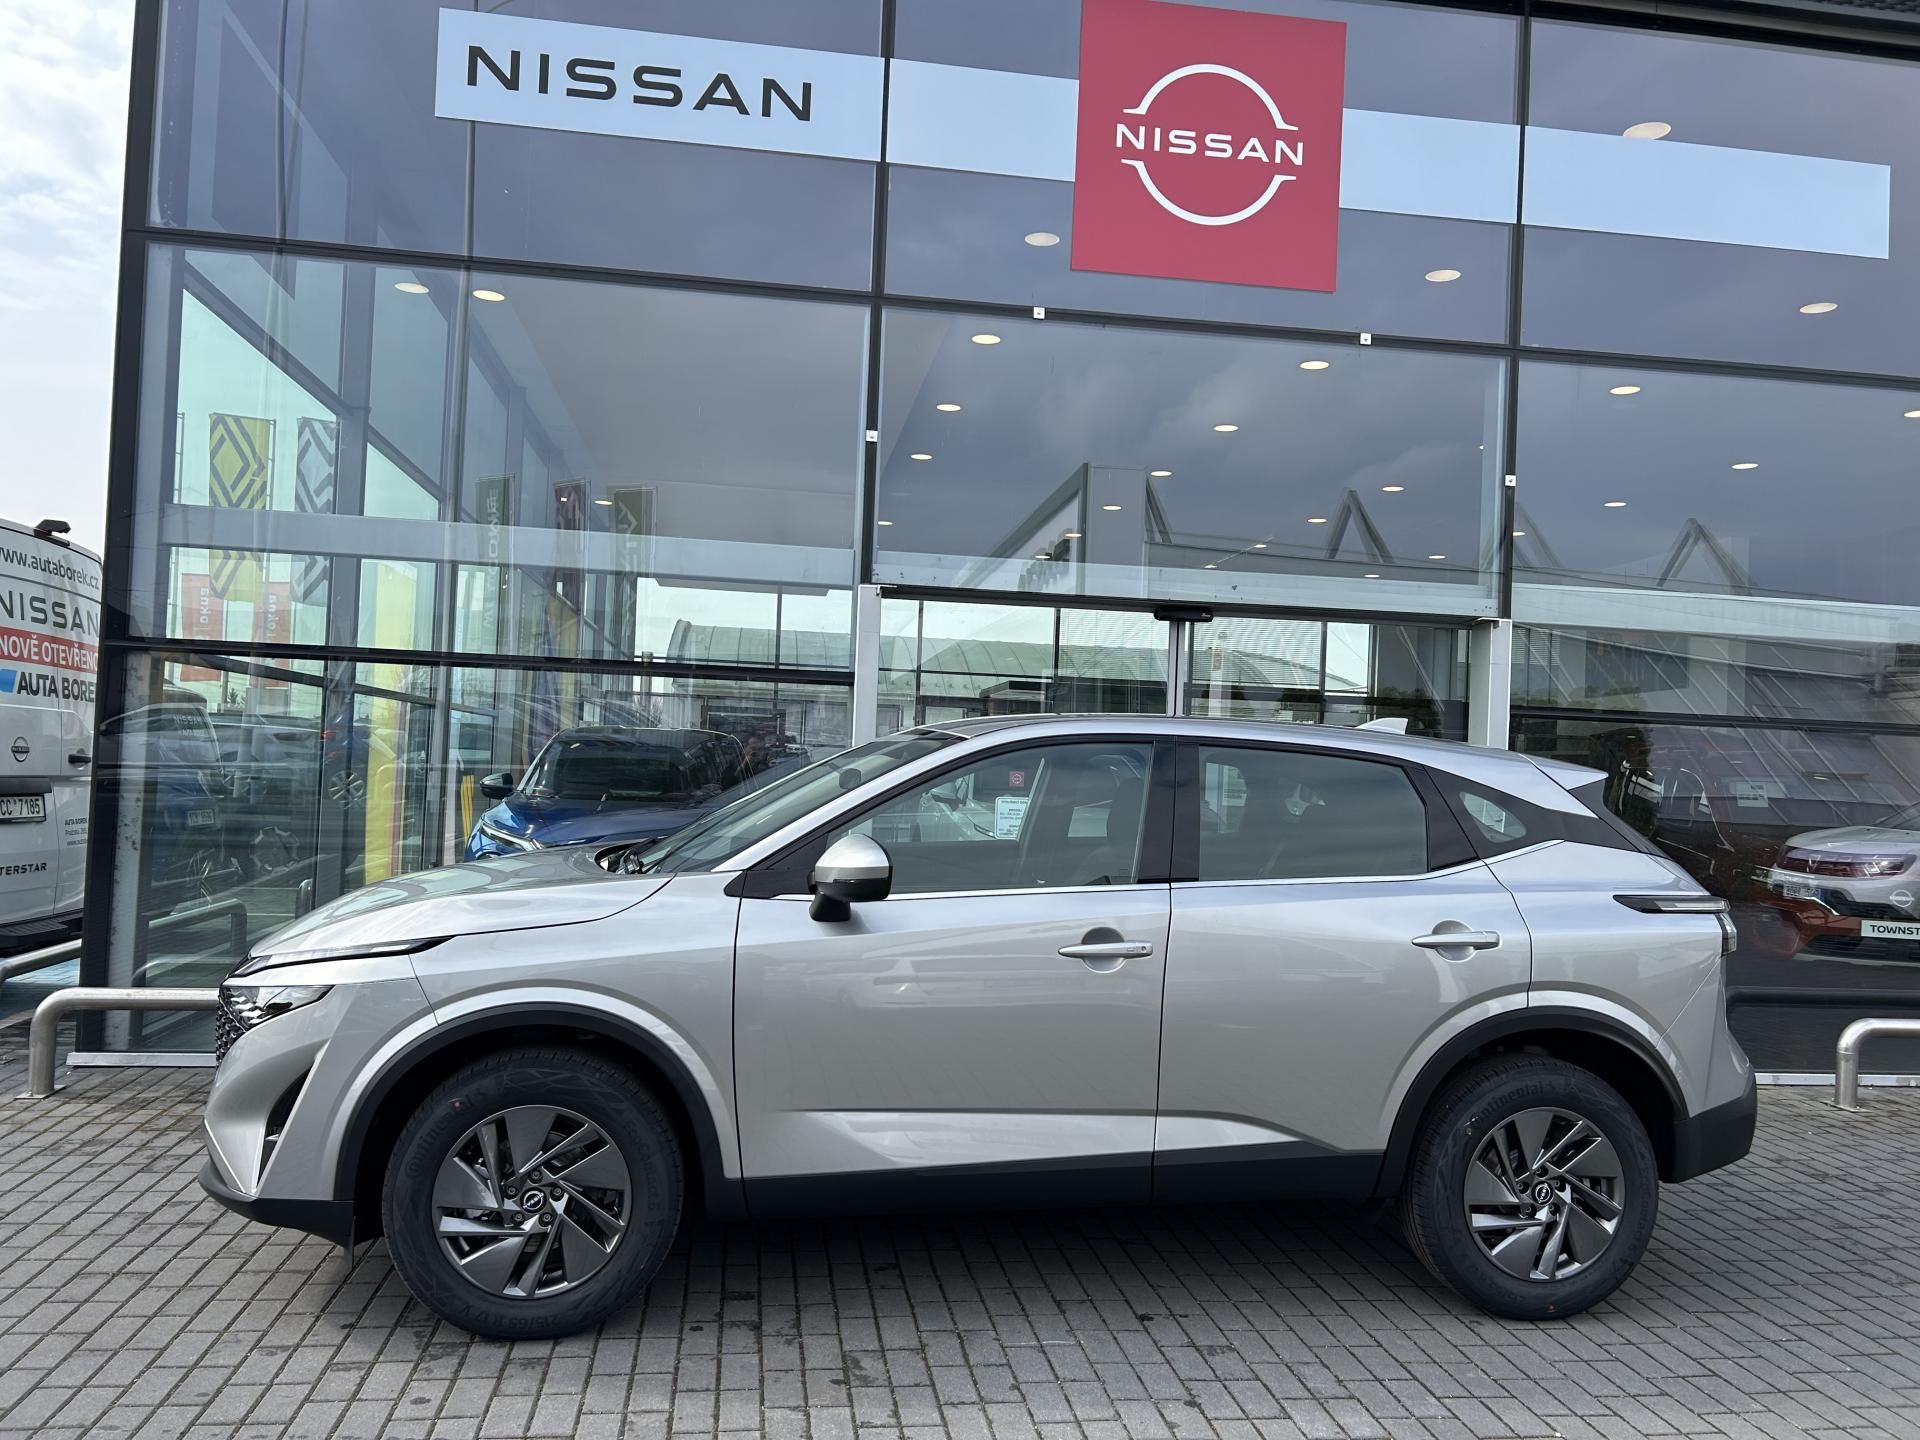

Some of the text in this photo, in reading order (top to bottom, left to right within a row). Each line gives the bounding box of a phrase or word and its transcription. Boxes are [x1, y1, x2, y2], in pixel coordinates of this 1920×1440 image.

[467, 44, 812, 122] NISSAN
[1116, 123, 1303, 166] NISSAN
[0, 546, 99, 590] ww.autaborek.cz
[0, 590, 98, 638] NISSAN
[0, 634, 39, 660] NOVĚ
[17, 671, 59, 698] AUTA
[19, 798, 40, 814] 7185
